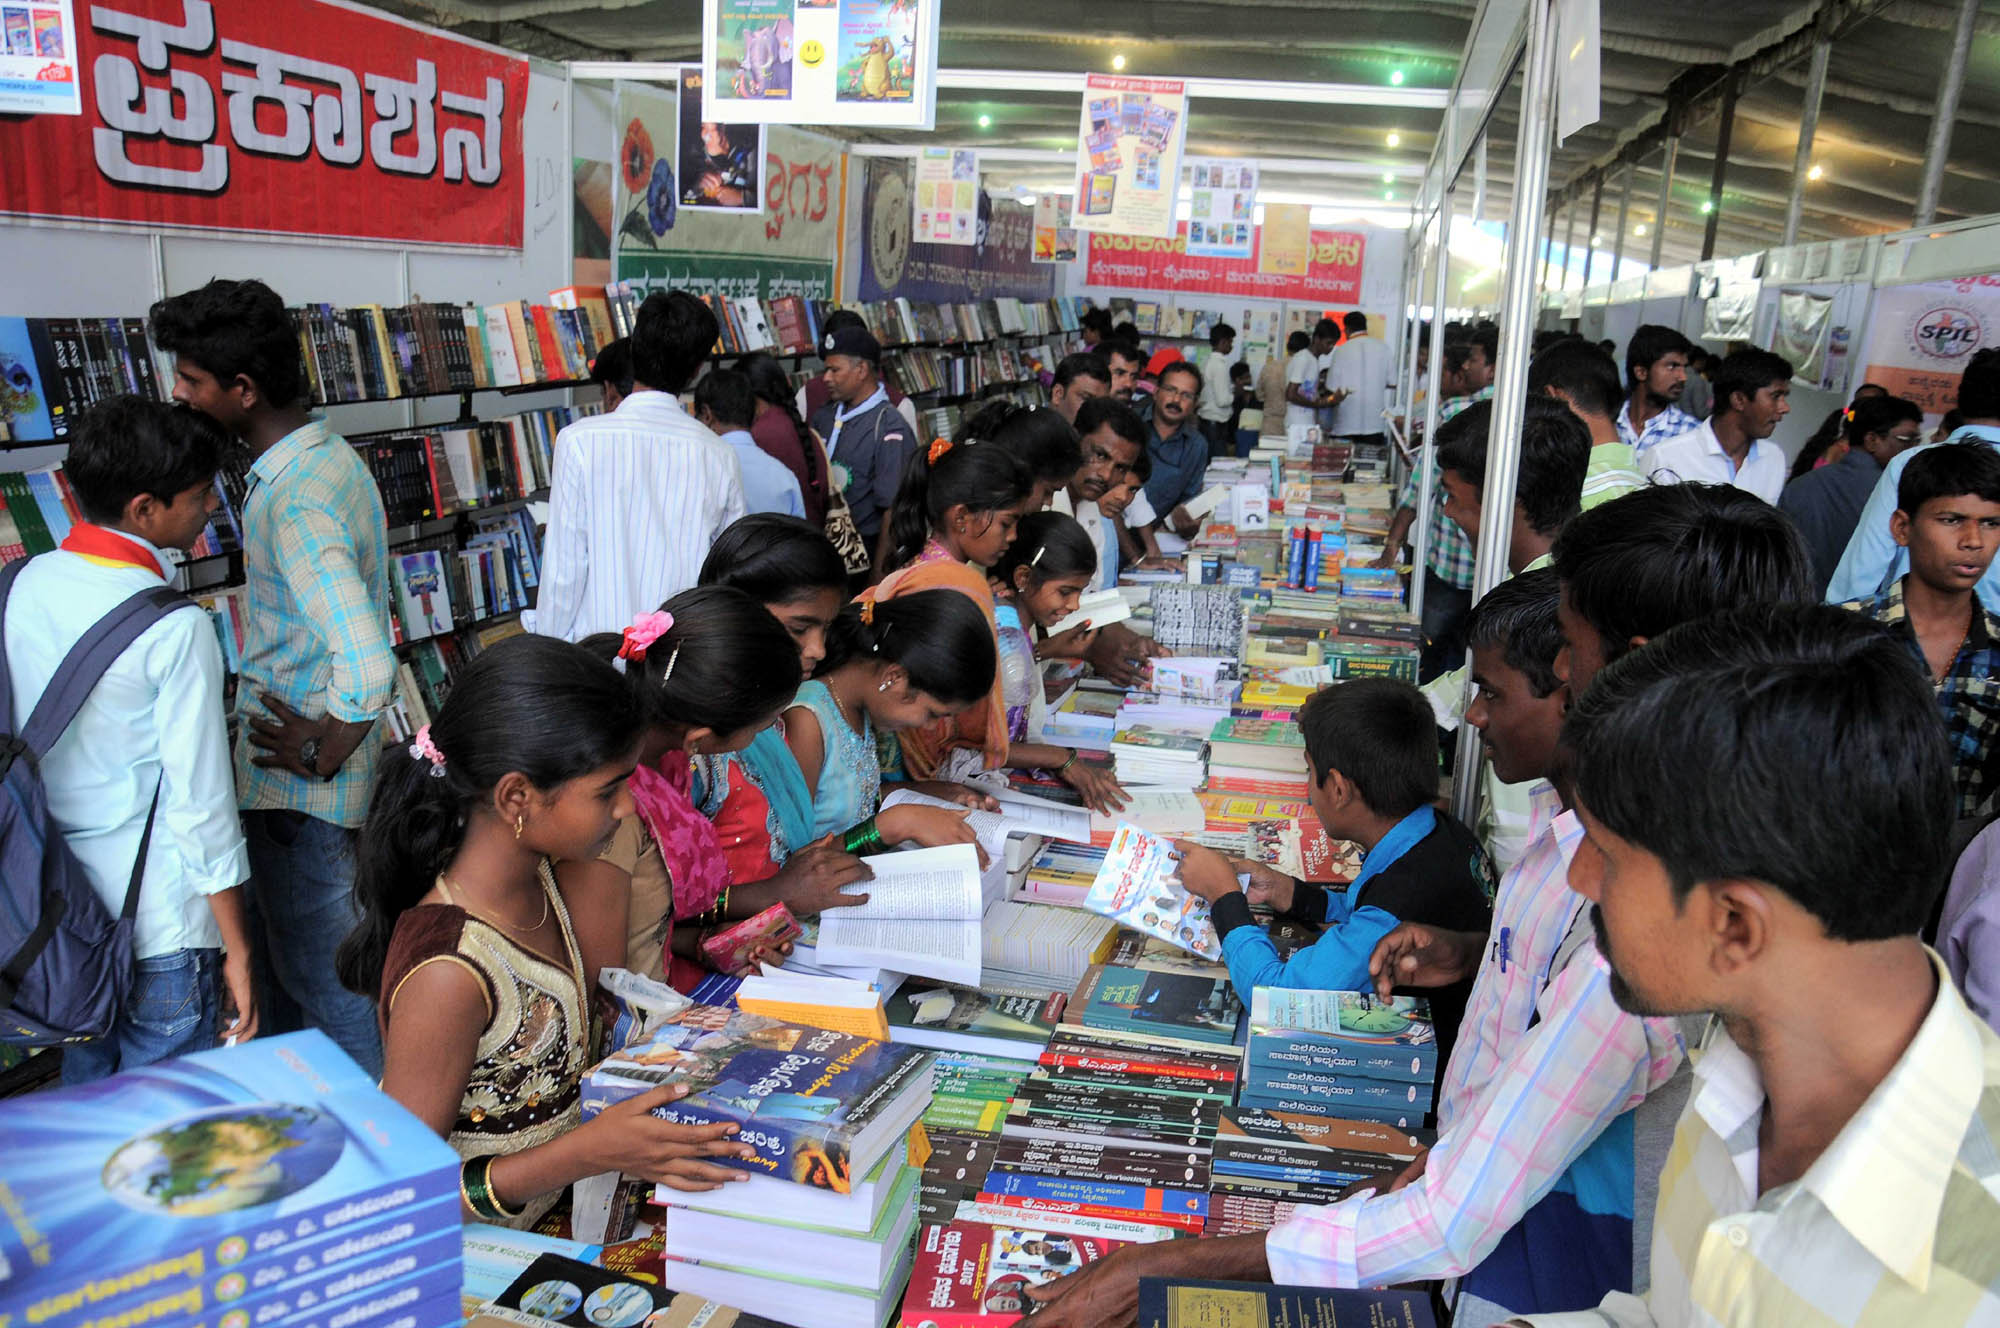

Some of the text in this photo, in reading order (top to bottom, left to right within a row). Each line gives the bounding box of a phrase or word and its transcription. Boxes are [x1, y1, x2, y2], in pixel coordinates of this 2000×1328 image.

[91, 0, 504, 192] ಪ್ರಕಾಶನ
[1920, 324, 1975, 343] SPIL
[1348, 661, 1392, 673] DICTIONARY
[1083, 1240, 1099, 1263] NTS
[959, 1259, 976, 1286] 2017
